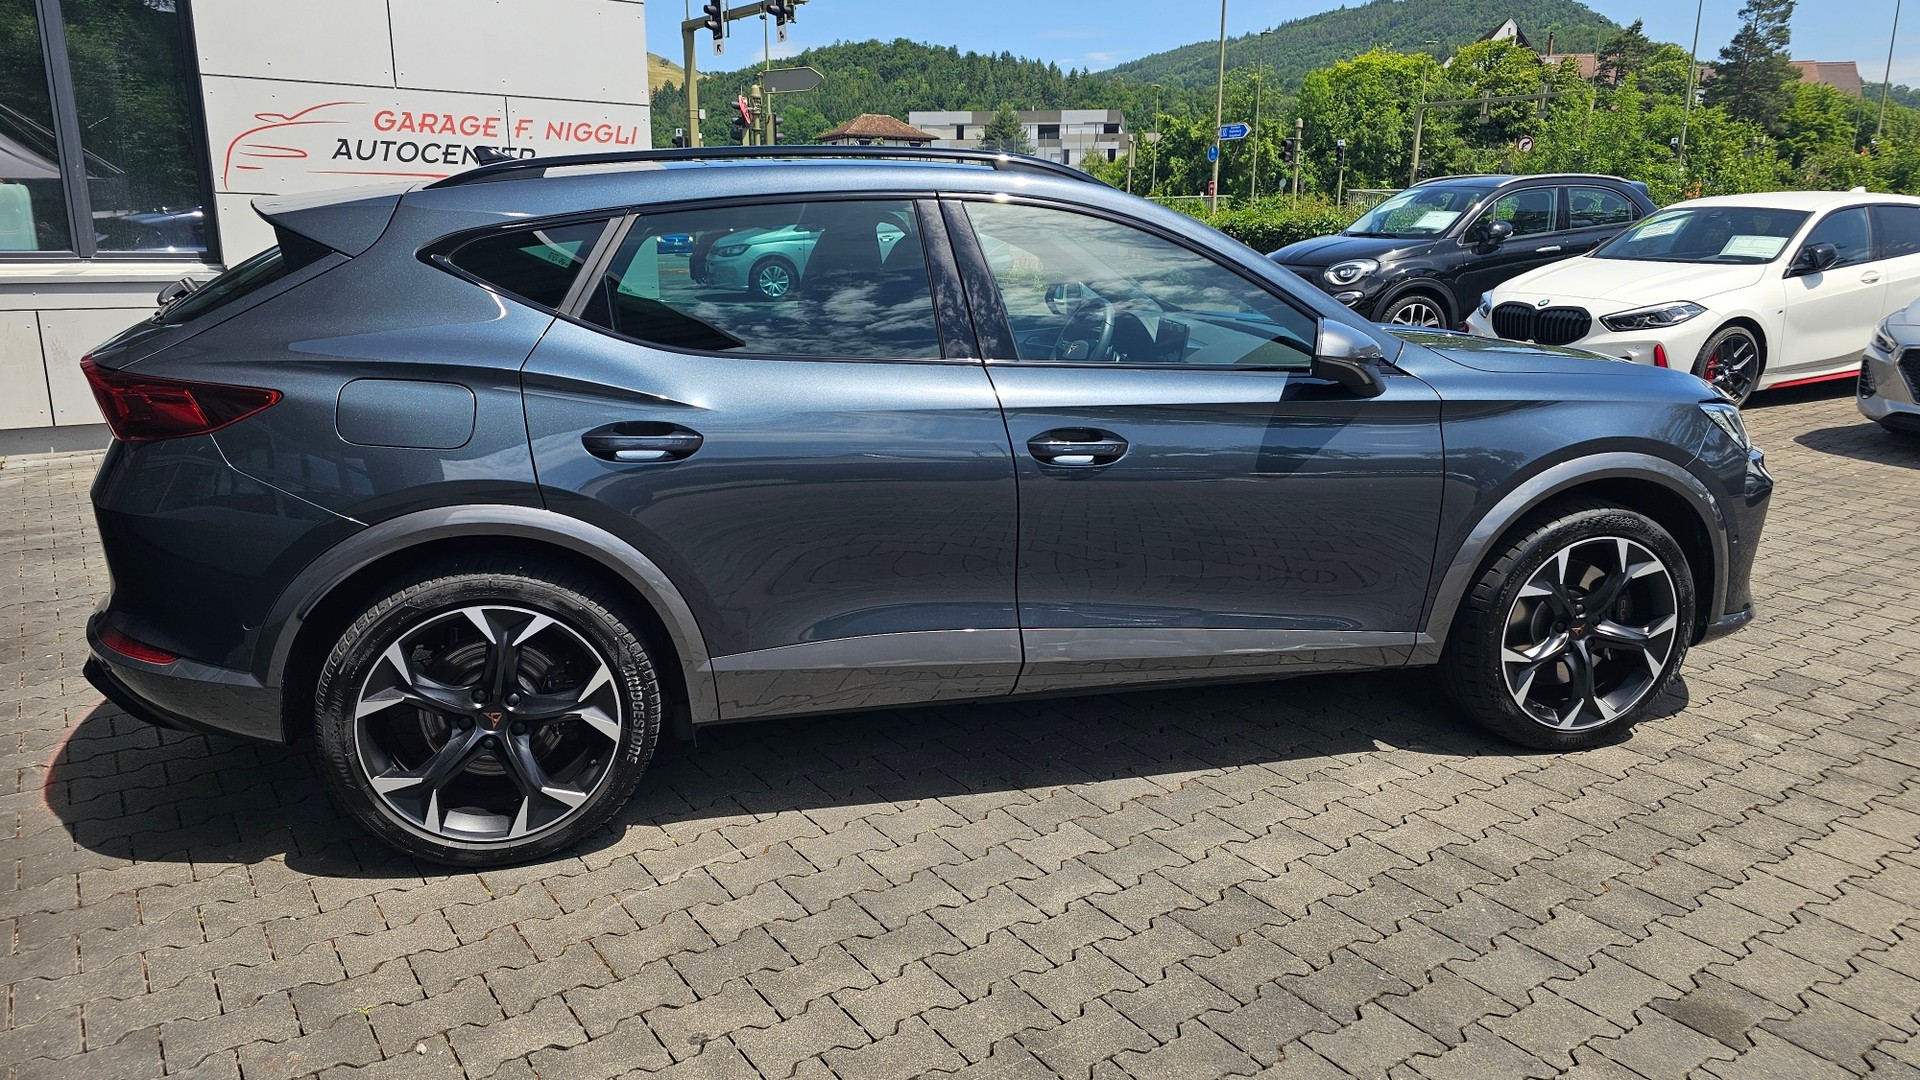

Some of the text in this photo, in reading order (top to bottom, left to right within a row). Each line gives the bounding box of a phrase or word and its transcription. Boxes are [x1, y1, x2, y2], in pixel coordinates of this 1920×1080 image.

[374, 109, 637, 144] GARAGE F. NIGGLI
[332, 138, 536, 165] AUTOCENR
[622, 663, 645, 764] BRIDGESTONE
